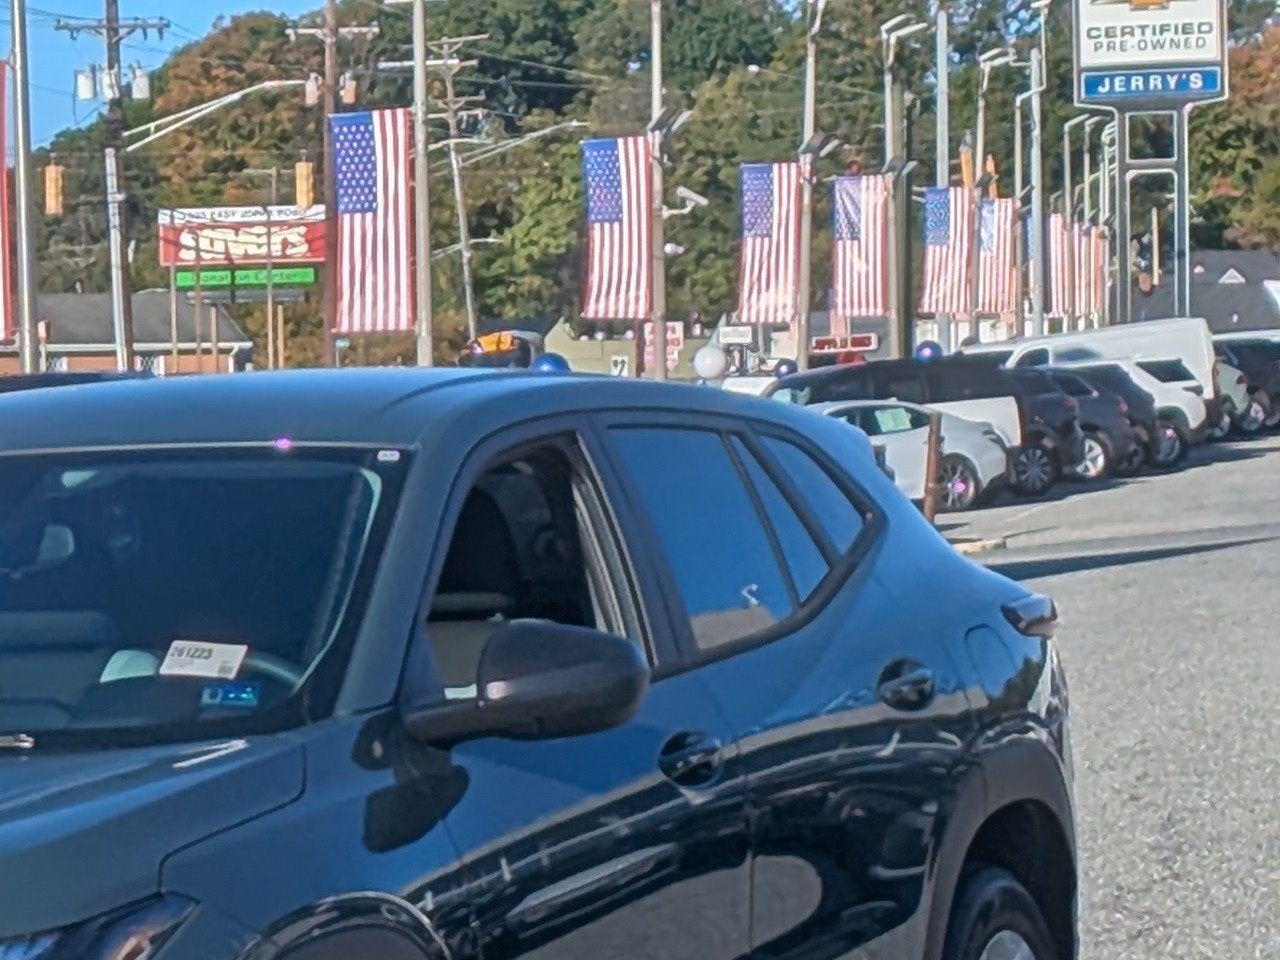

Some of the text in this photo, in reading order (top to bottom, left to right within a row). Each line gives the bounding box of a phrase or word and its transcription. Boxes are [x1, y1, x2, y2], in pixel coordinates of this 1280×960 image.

[1086, 22, 1214, 39] CERTIFIED
[1094, 37, 1206, 52] PRE-OWNED
[1098, 73, 1203, 93] JERRY'S
